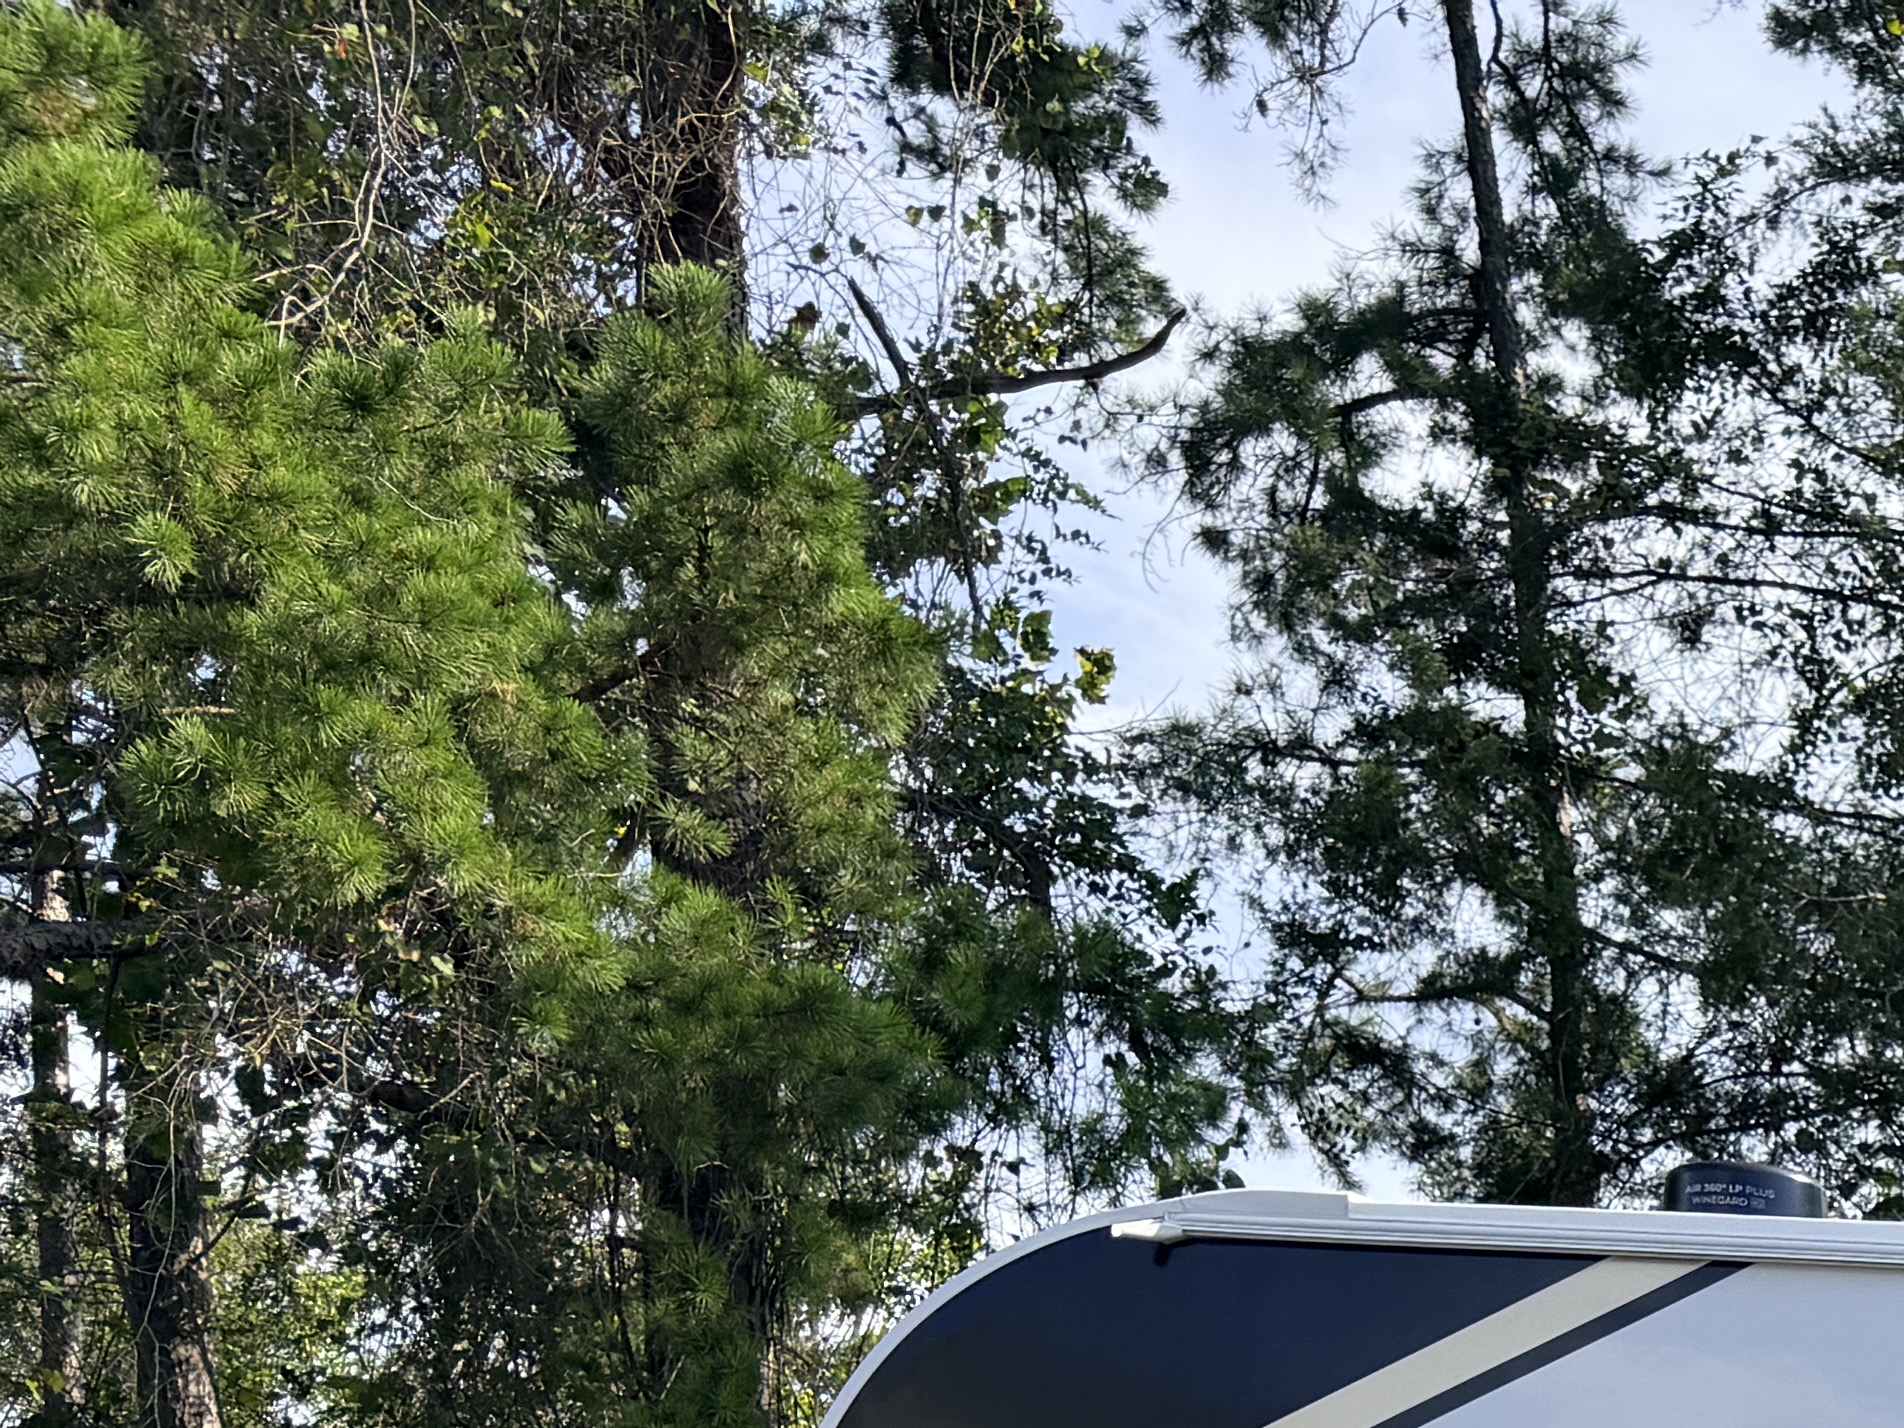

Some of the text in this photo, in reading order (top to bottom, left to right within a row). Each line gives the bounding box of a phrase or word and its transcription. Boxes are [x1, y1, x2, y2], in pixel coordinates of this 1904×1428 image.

[1728, 1184, 1743, 1193] LP
[1745, 1185, 1775, 1199] PLUS
[1691, 1195, 1748, 1206] WINEGARD
